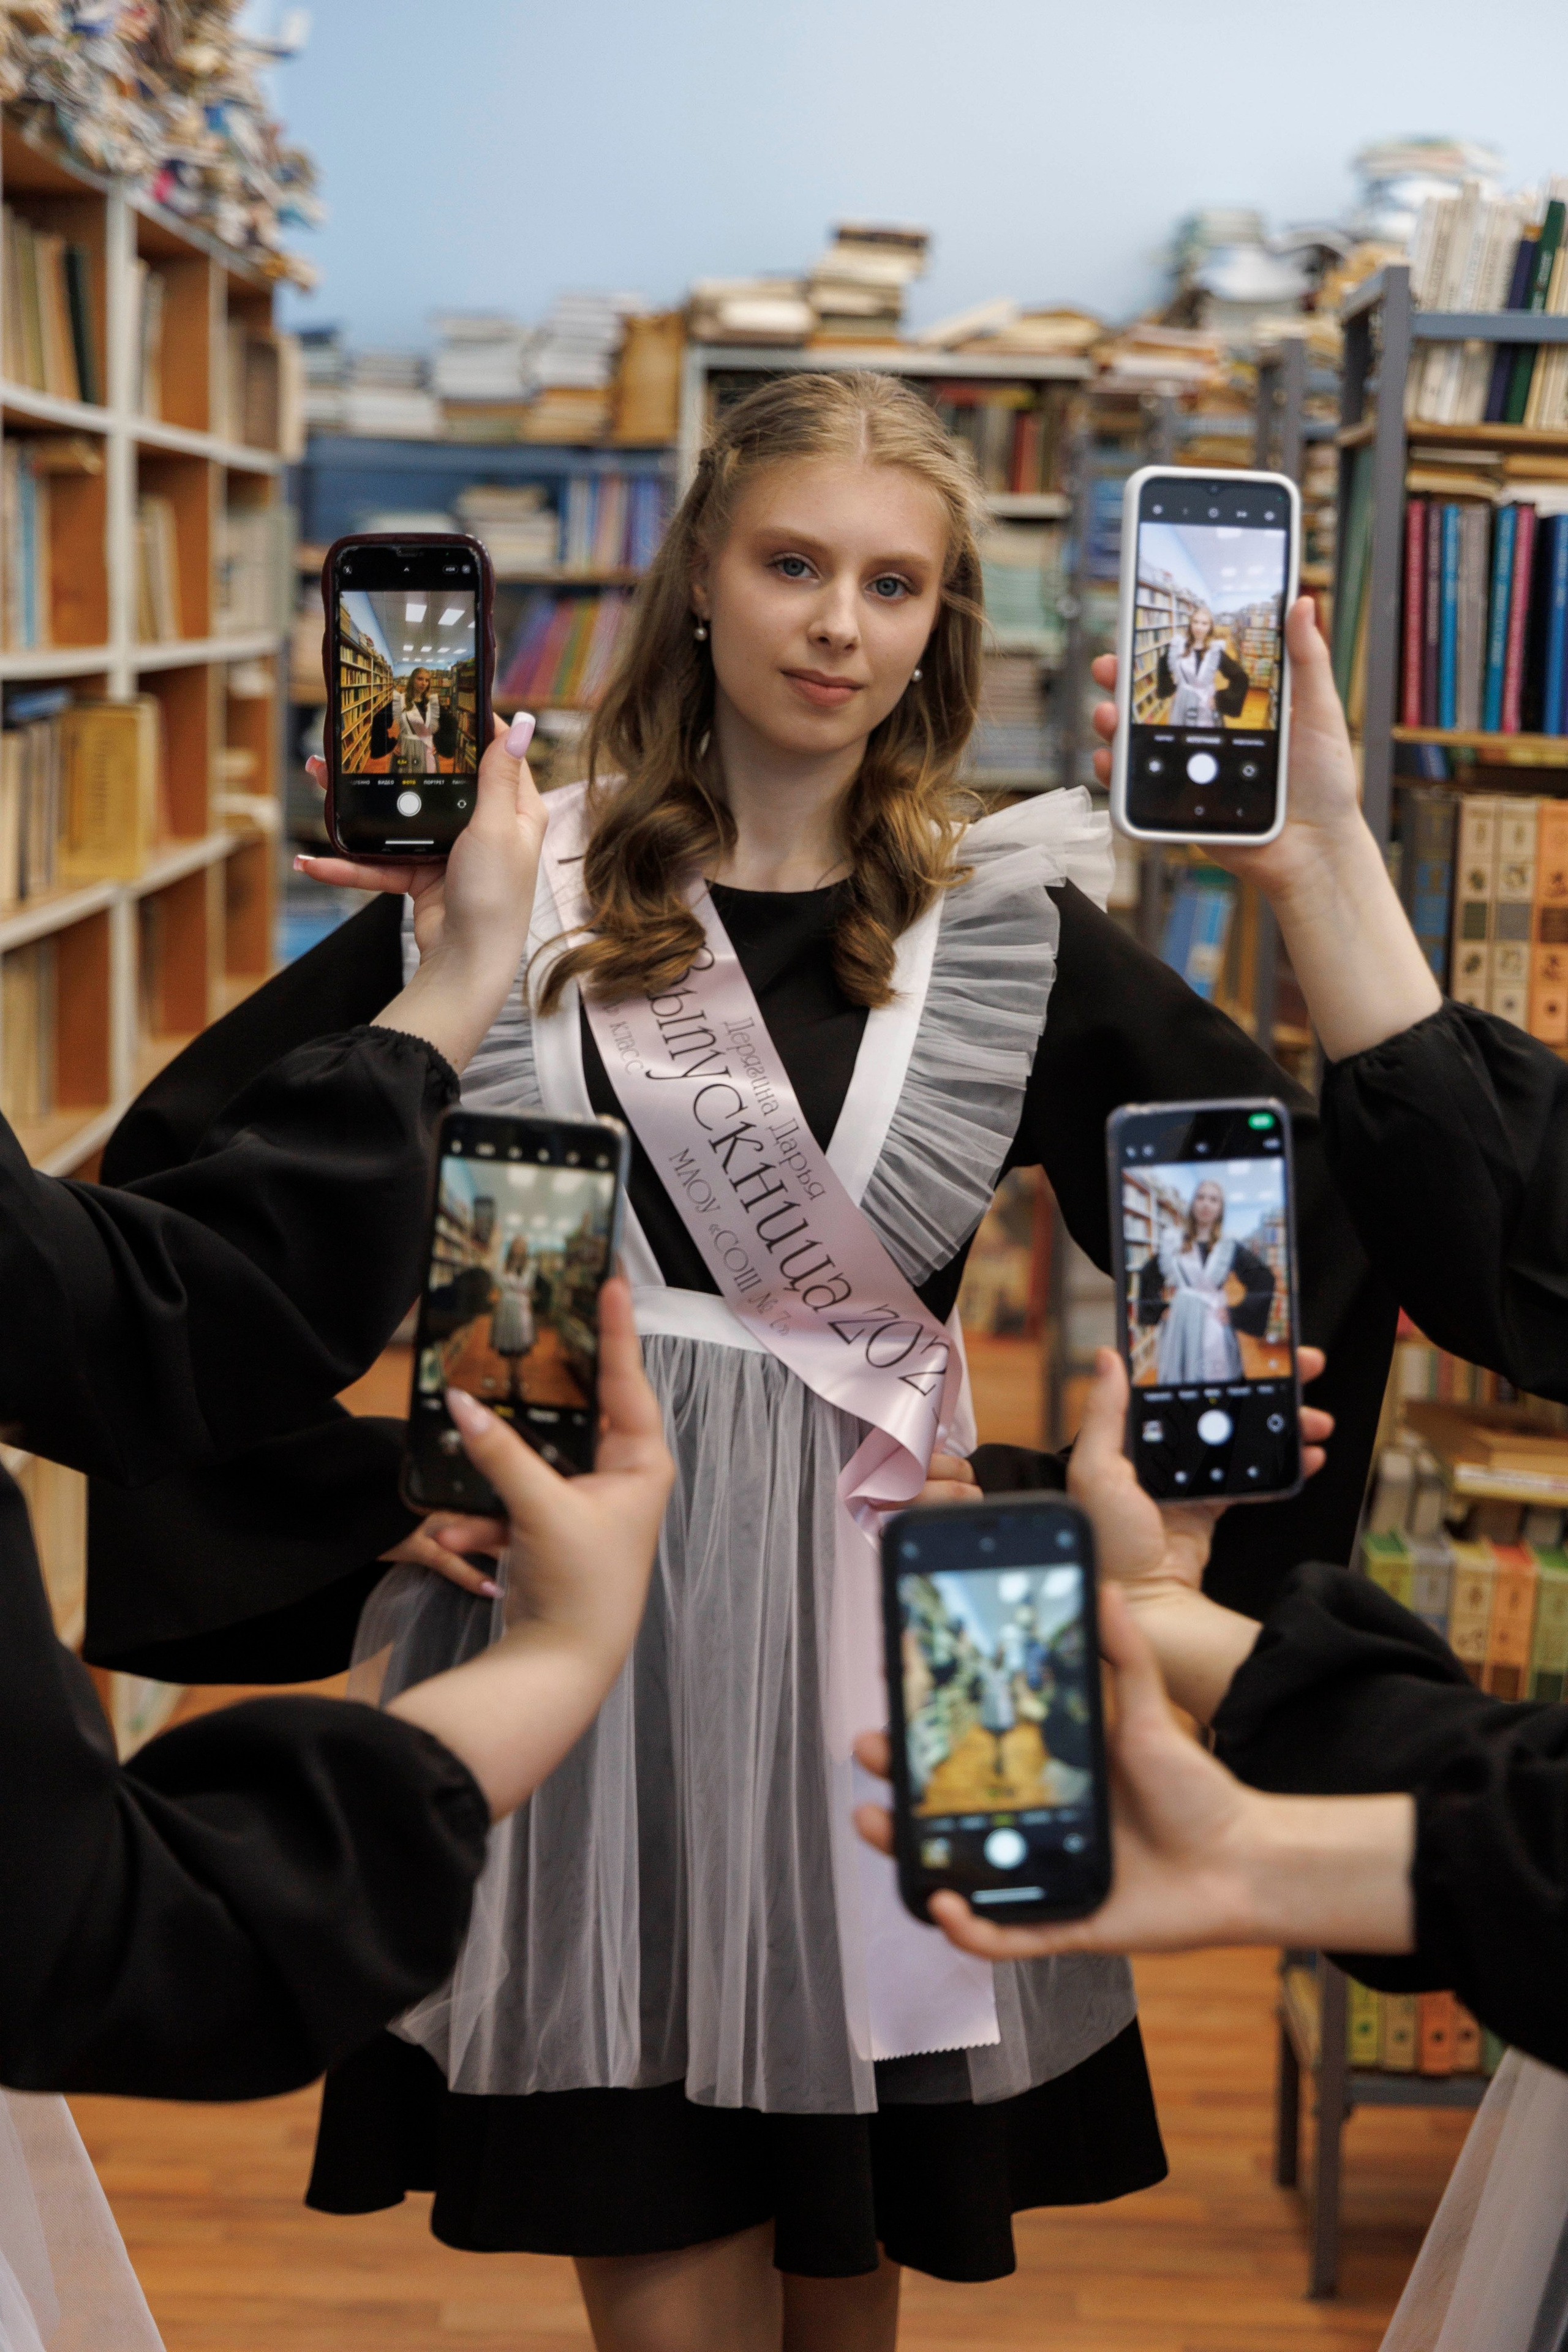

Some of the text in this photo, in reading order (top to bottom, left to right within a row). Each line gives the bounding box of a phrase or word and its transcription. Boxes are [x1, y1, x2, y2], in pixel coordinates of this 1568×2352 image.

[609, 1020, 644, 1076] класс
[723, 1016, 826, 1201] Дерягина Дарья
[827, 1303, 949, 1422] 202
